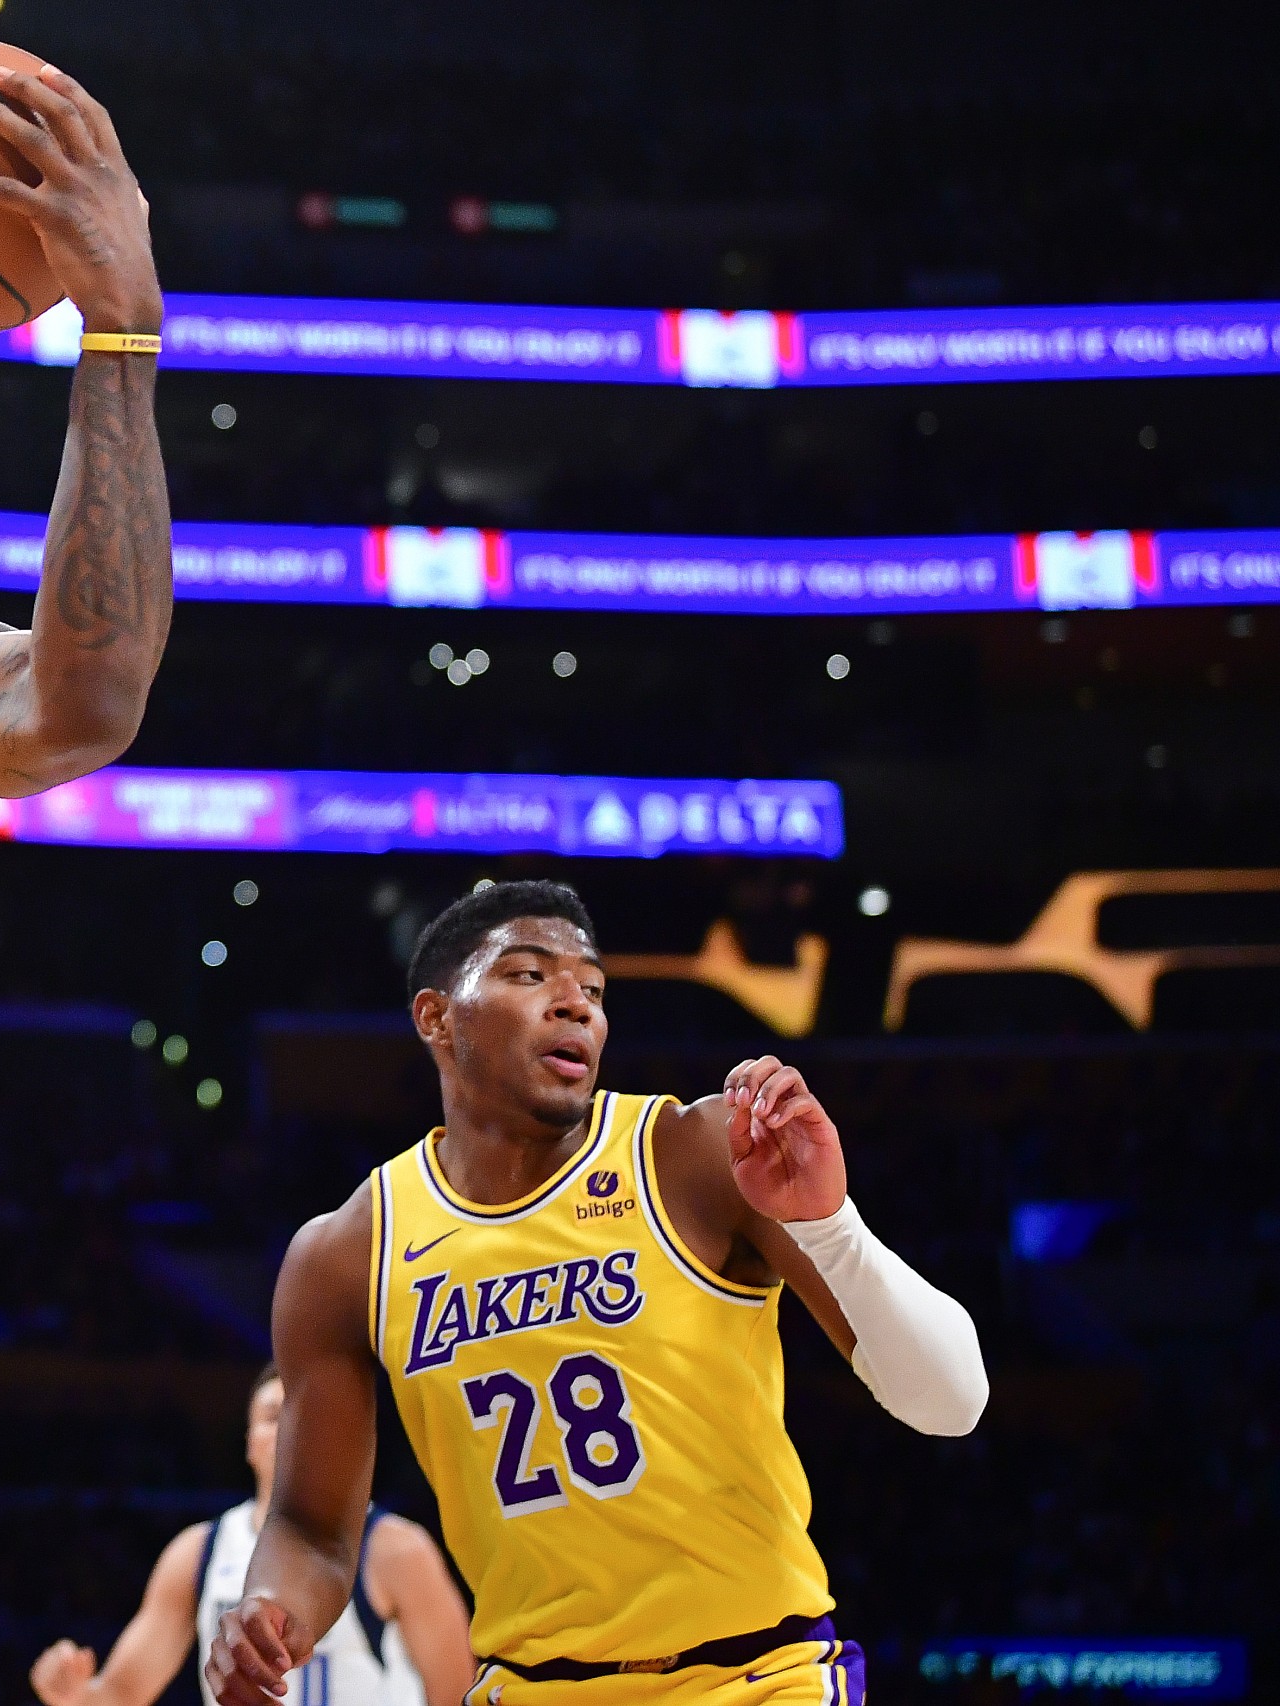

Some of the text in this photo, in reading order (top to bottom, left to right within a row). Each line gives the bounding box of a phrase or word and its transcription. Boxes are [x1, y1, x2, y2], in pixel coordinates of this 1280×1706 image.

[637, 790, 821, 842] DELTA
[576, 1197, 635, 1219] bibigo
[404, 1250, 645, 1379] LAKERS
[461, 1350, 647, 1520] 28
